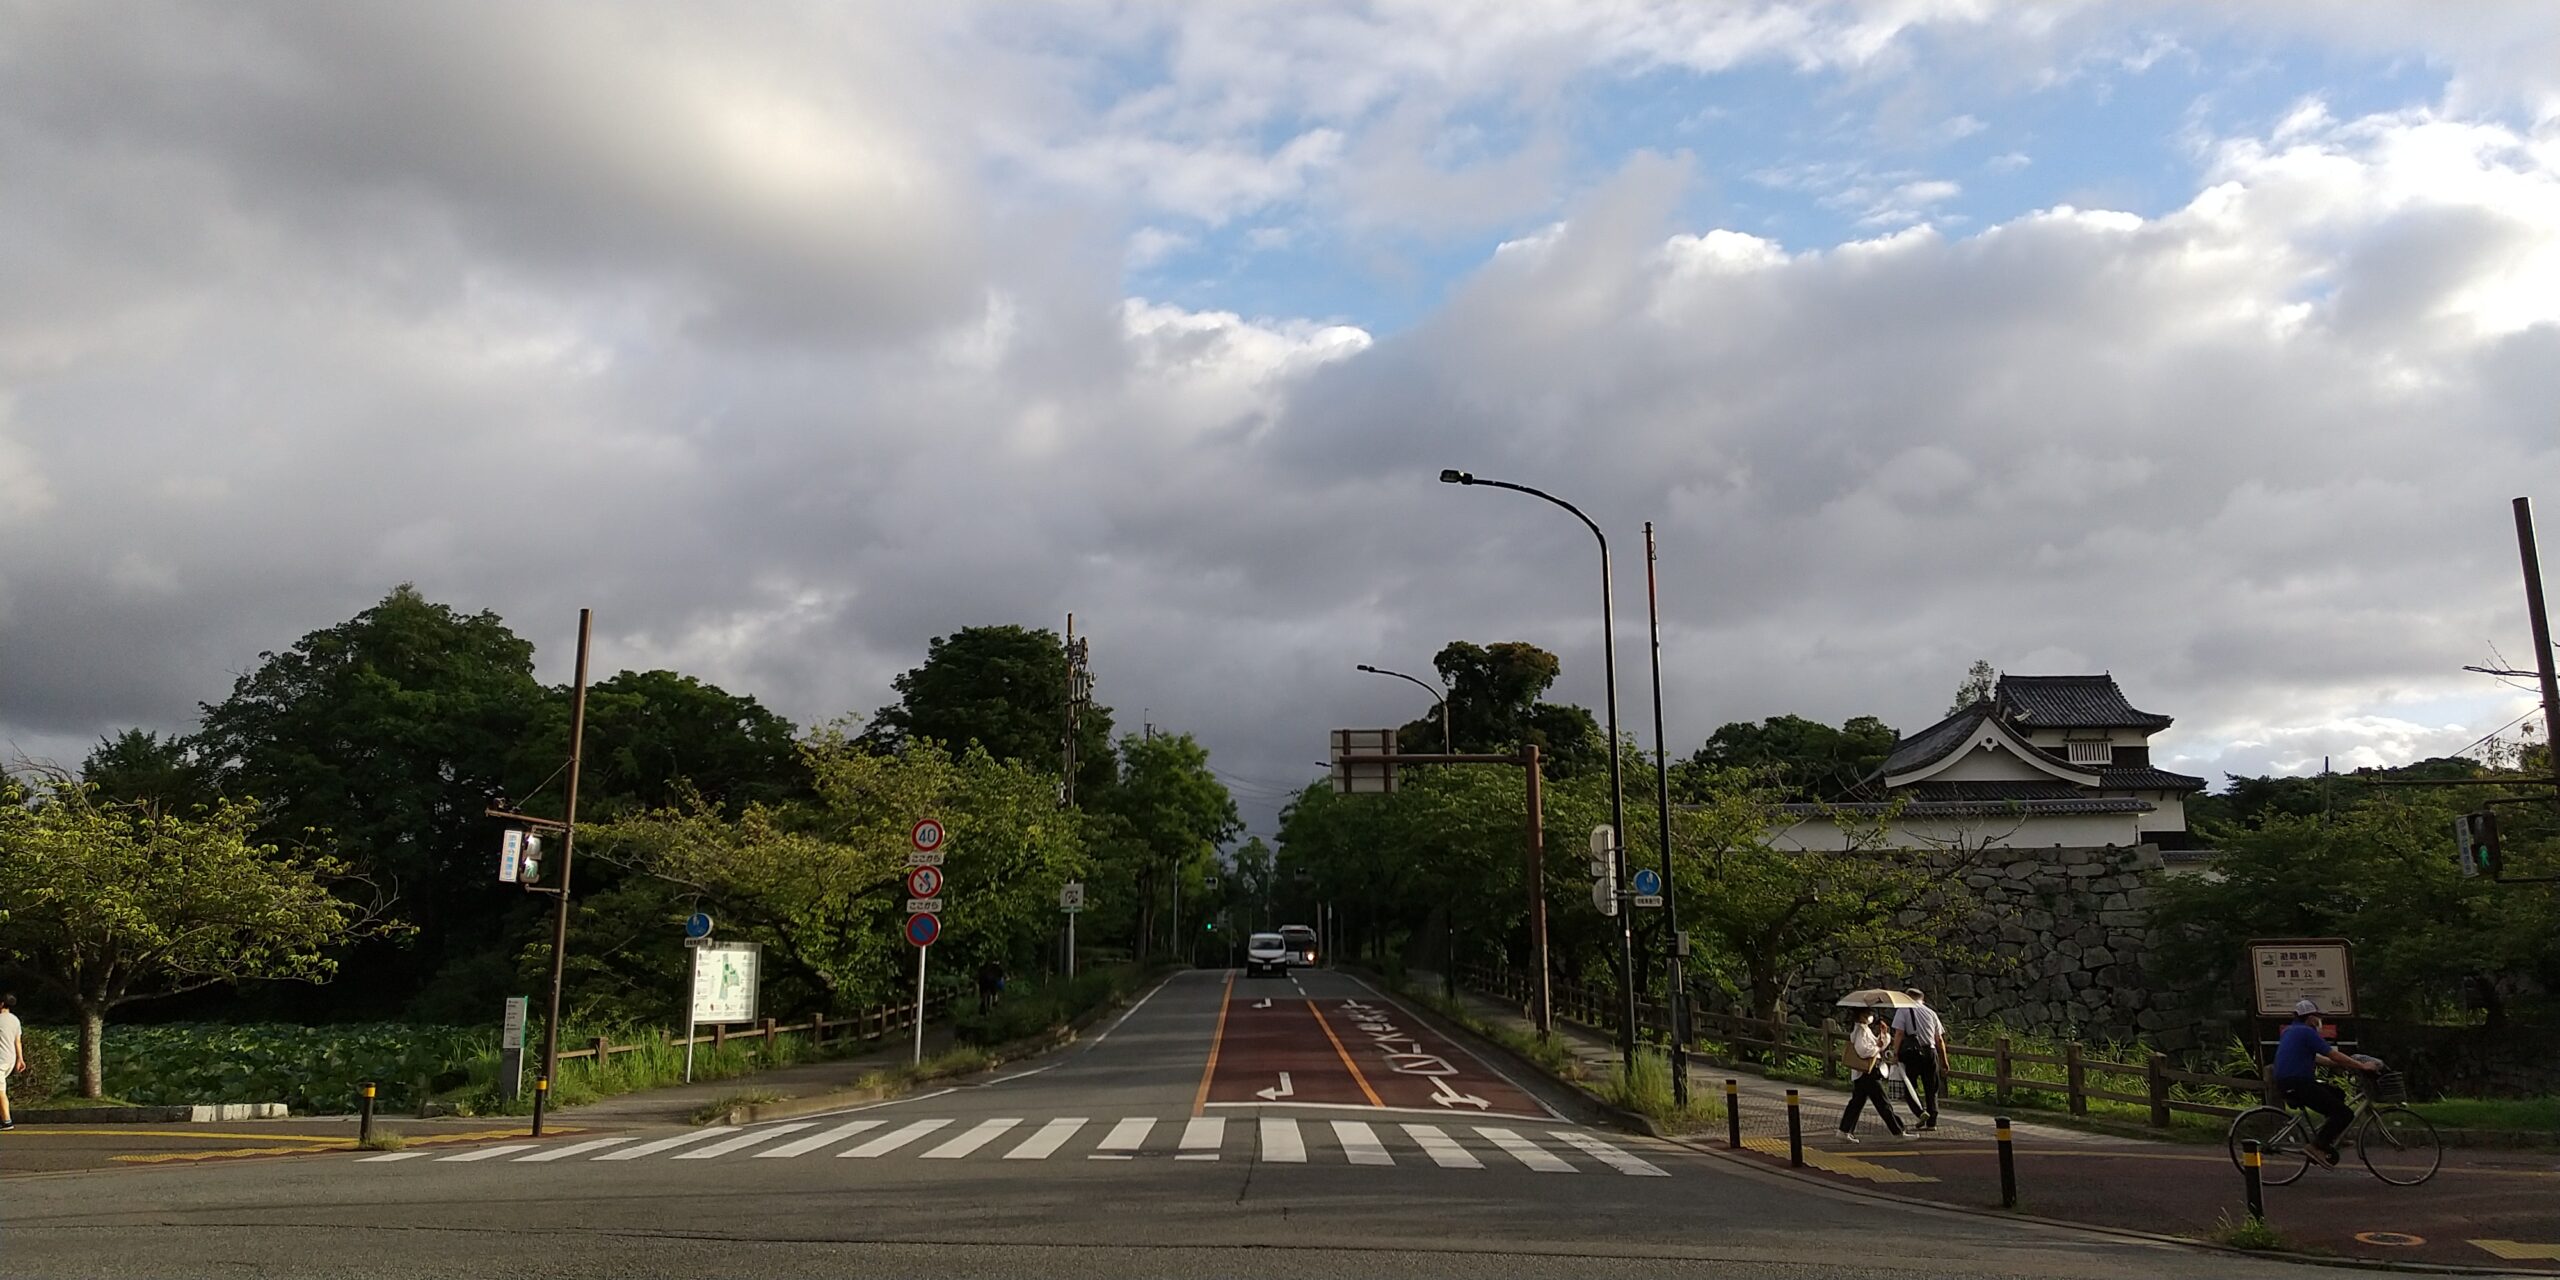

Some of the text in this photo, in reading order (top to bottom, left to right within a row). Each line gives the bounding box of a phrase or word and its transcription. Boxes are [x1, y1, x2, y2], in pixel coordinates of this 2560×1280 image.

[918, 828, 937, 844] 40
[911, 854, 940, 863] ここから
[909, 901, 939, 910] ここから
